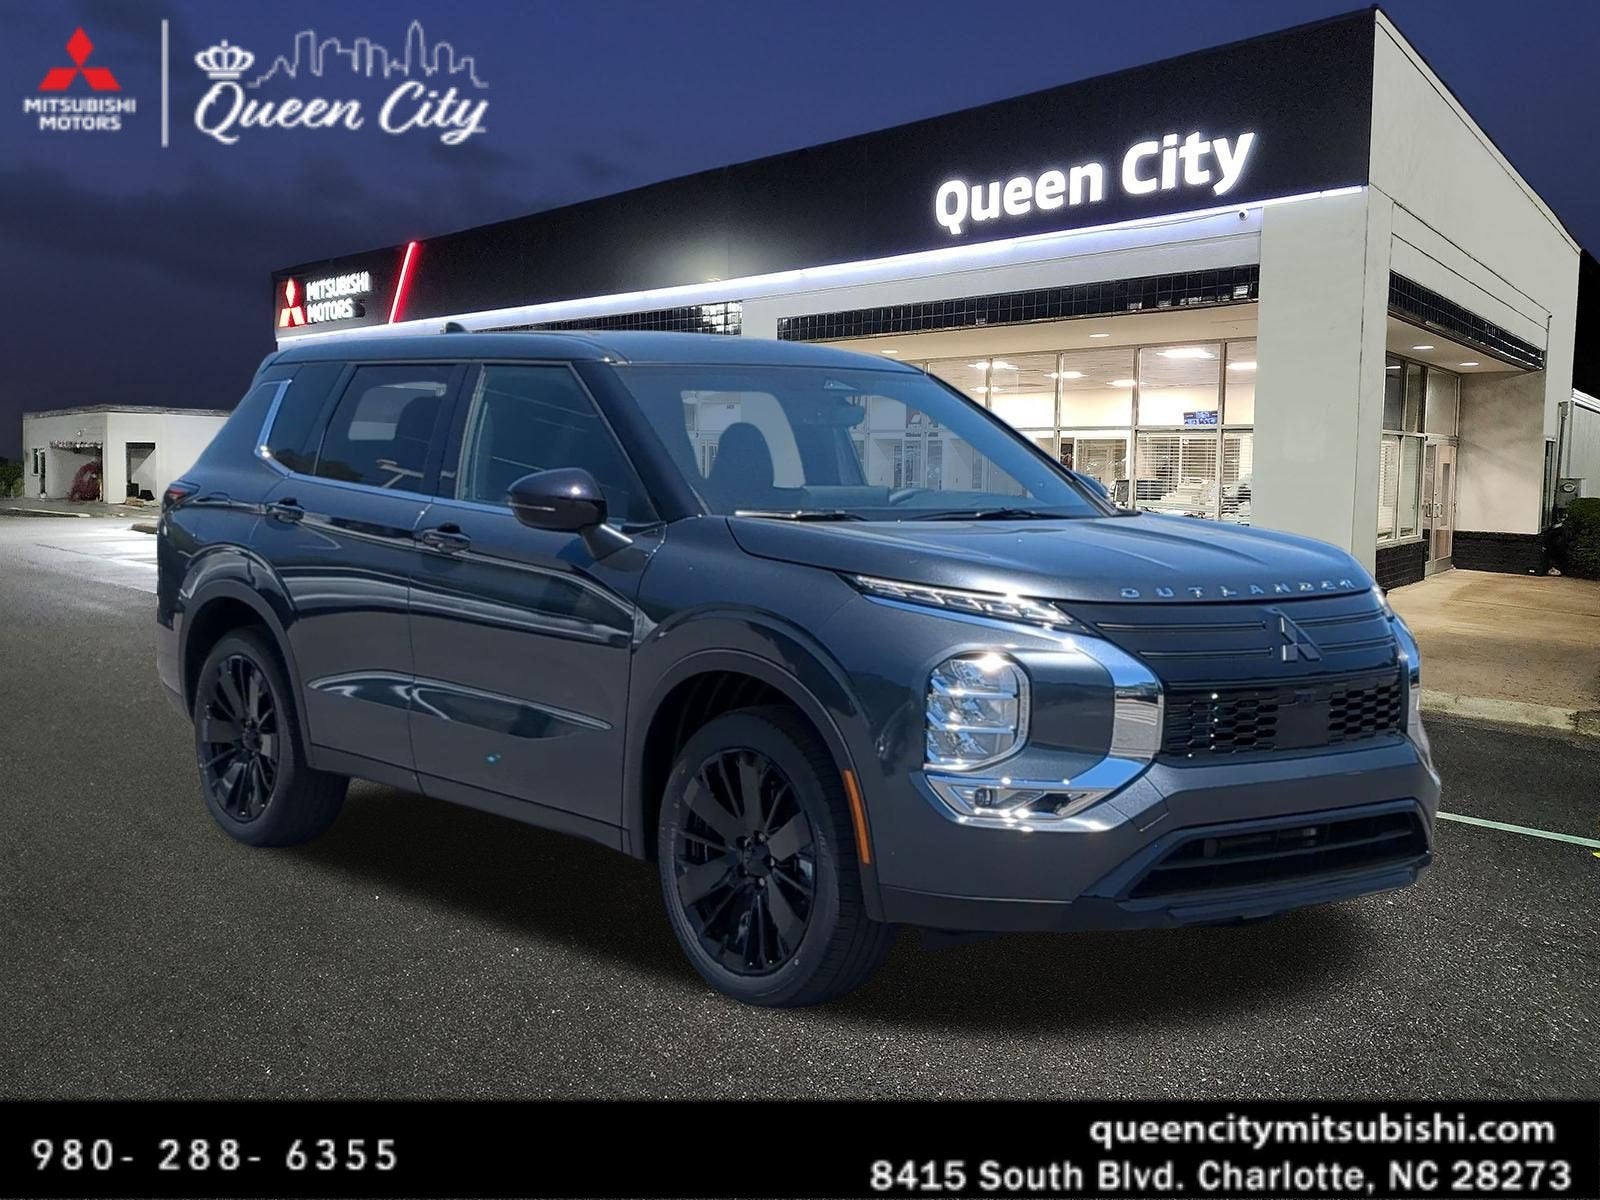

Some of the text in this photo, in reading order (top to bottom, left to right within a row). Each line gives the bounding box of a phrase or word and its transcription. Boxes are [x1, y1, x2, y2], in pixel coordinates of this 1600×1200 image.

[935, 131, 1256, 235] Queen City
[306, 270, 371, 301] MITSUBISHI
[306, 297, 355, 323] MOTORS
[1120, 578, 1356, 599] OUTLANDER
